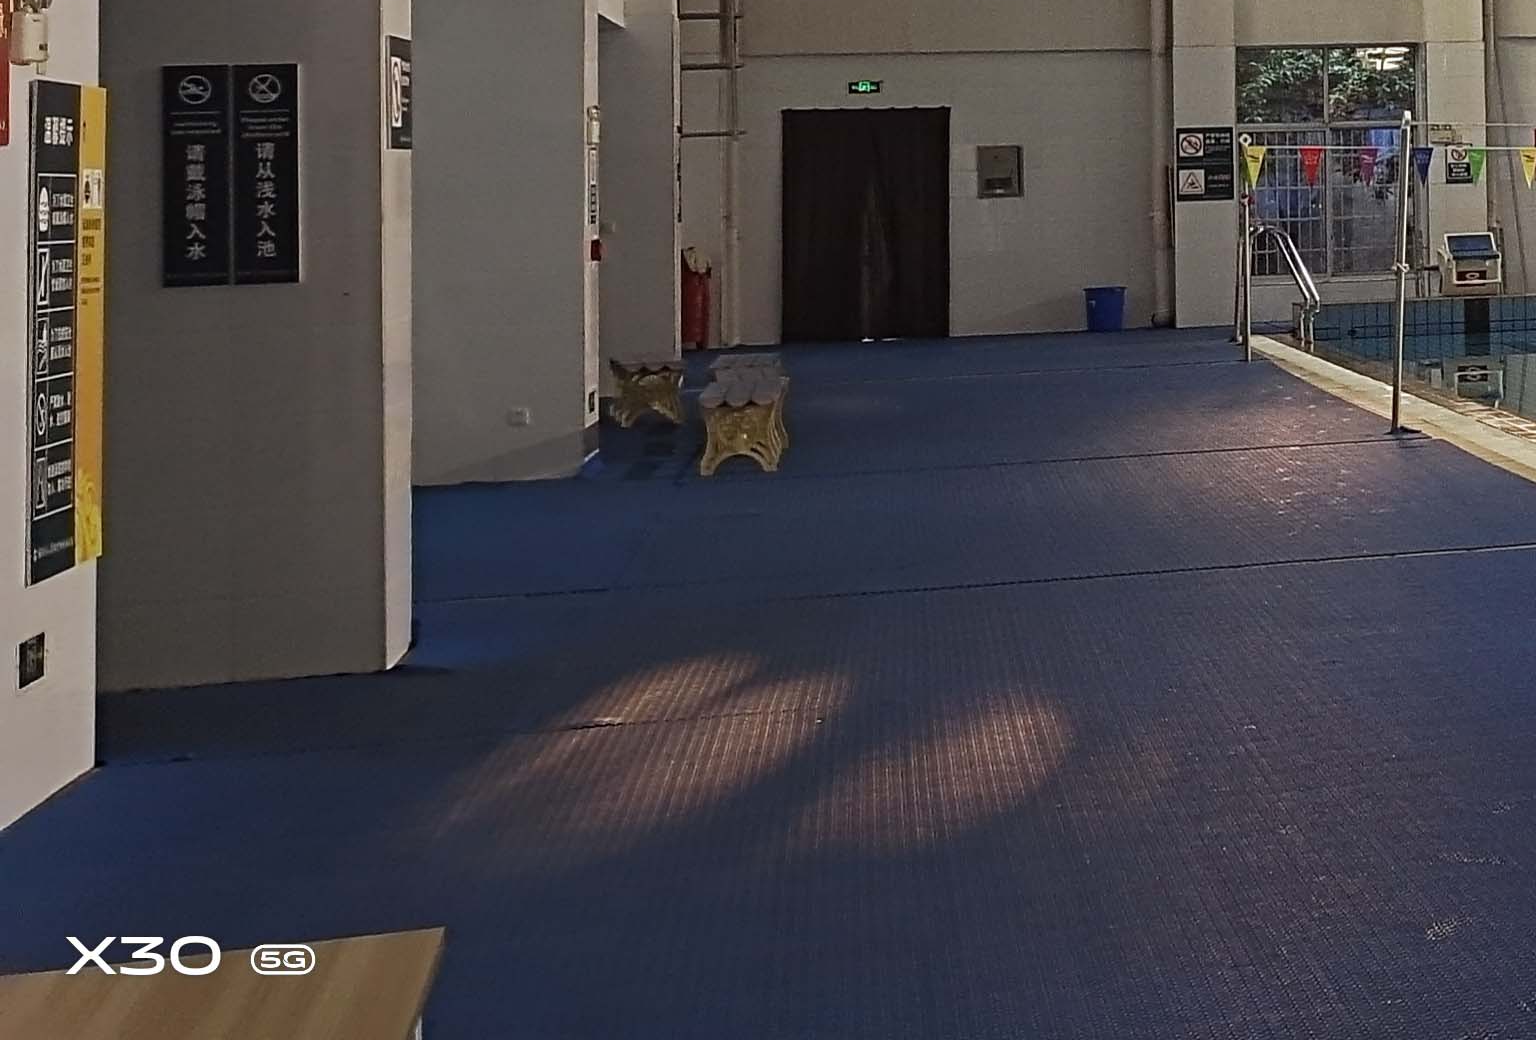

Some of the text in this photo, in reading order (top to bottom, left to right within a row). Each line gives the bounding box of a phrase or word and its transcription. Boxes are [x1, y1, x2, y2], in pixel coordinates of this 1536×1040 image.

[185, 144, 207, 260] 请戴泳帽入水
[255, 142, 278, 257] 请从浅水入池
